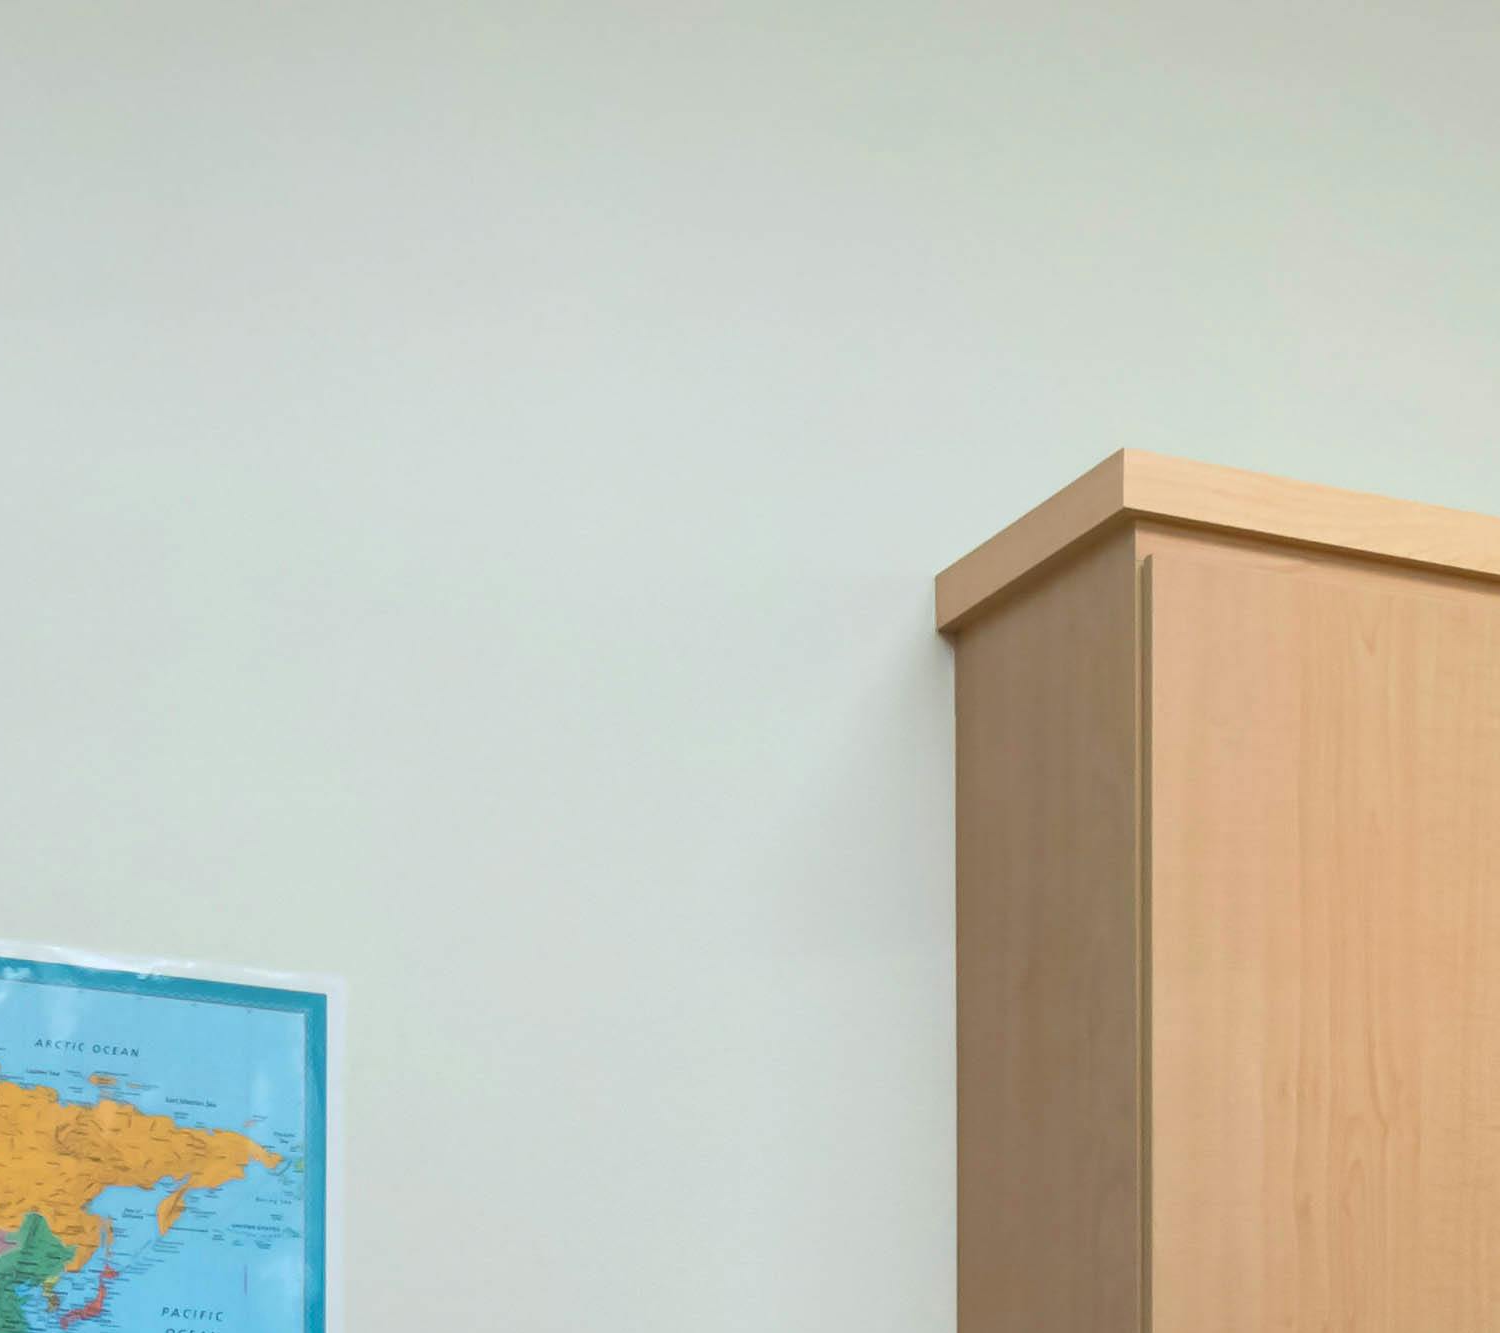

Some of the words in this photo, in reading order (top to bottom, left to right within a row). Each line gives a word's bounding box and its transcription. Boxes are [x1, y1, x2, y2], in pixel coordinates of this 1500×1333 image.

[34, 1038, 84, 1052] ARCTIC
[92, 1043, 140, 1057] OCEAN
[162, 1306, 224, 1322] PACIFIC
